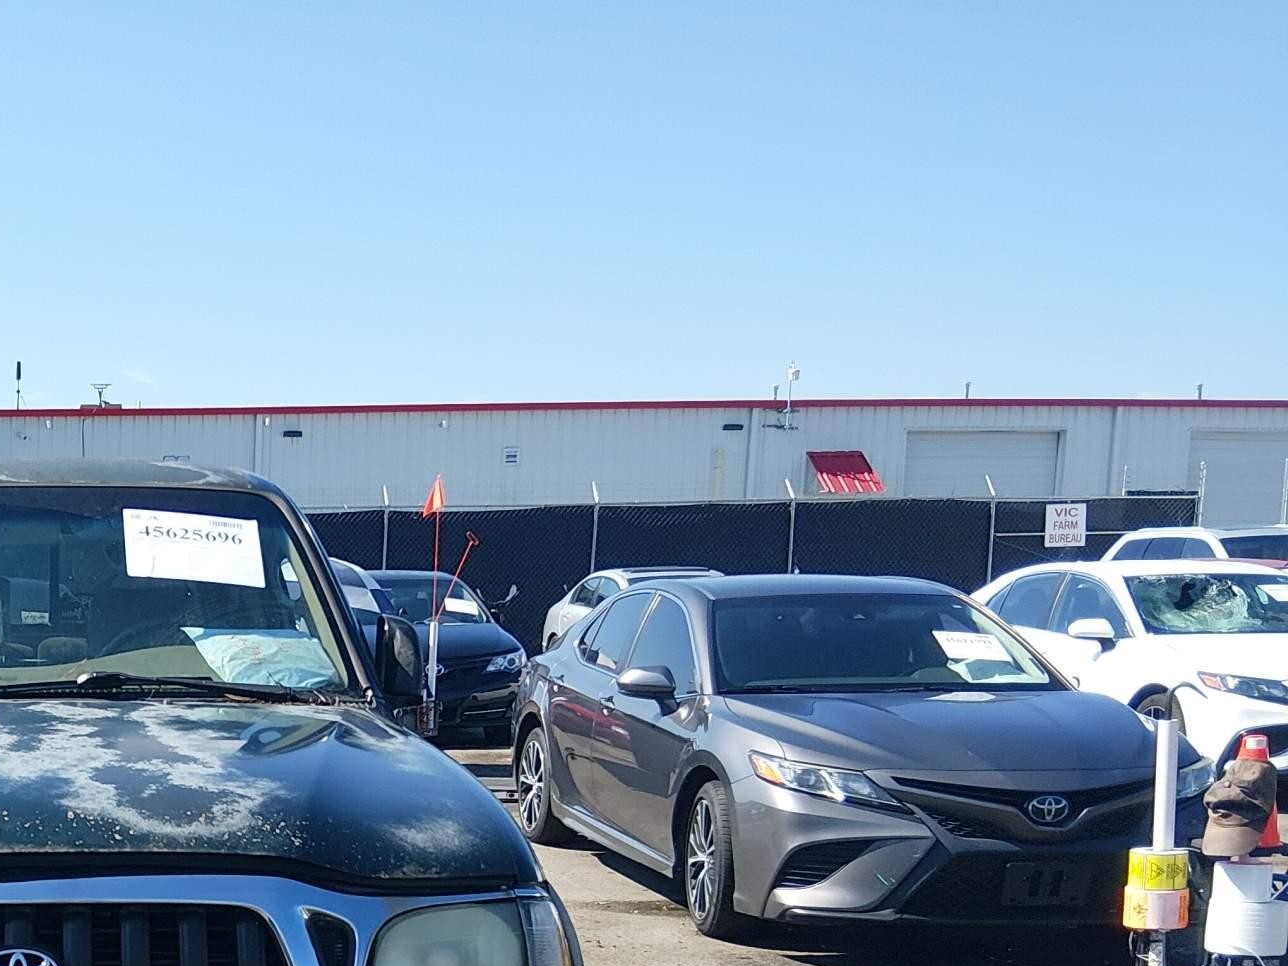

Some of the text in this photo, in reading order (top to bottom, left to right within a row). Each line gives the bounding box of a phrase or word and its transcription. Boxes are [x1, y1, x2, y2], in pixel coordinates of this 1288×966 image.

[1054, 507, 1079, 517] VIC
[1053, 520, 1078, 531] FARM
[139, 524, 243, 545] 45625696
[1048, 533, 1082, 544] BUREAU
